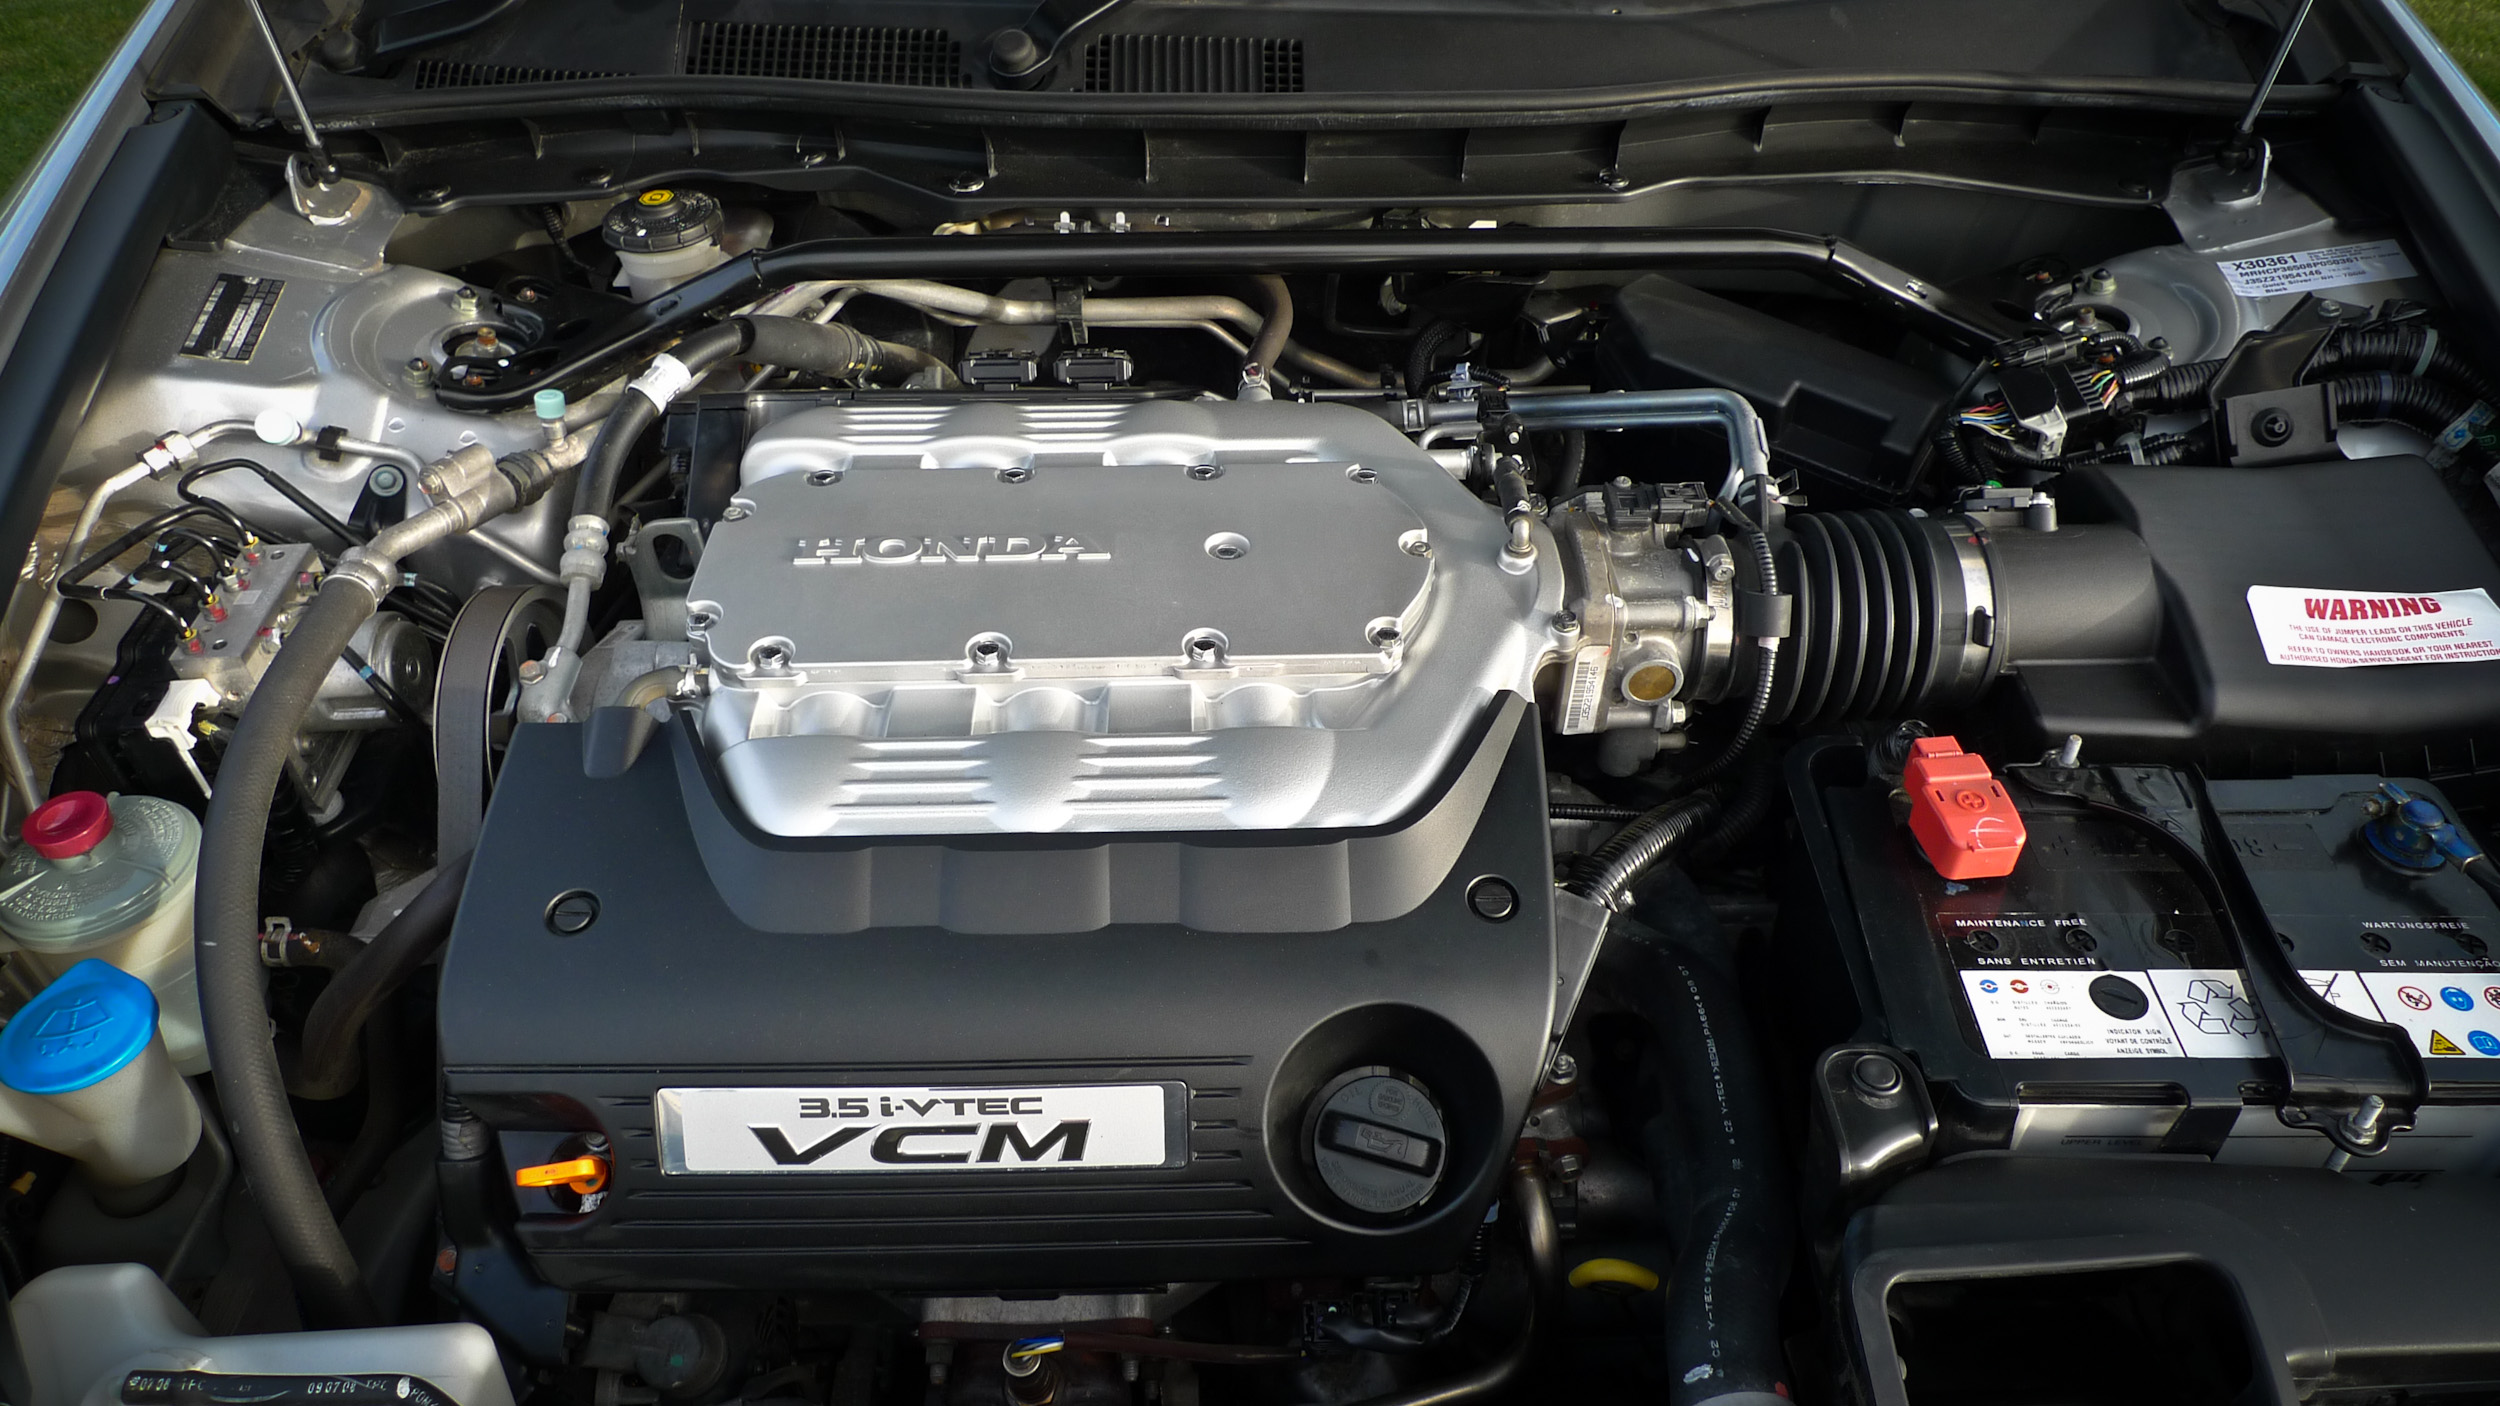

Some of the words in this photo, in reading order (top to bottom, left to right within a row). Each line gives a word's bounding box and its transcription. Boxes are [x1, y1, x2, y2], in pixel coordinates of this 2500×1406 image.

[2232, 254, 2297, 271] X30361
[2244, 269, 2322, 285] J35Z21954146
[793, 534, 1111, 564] HONDA
[2304, 597, 2442, 620] WARNING
[2289, 624, 2303, 632] THE
[2305, 625, 2320, 633] USE
[2335, 628, 2367, 636] JUMPER
[2369, 627, 2397, 636] LEADS
[2398, 625, 2412, 633] ON
[2412, 623, 2434, 632] THIS
[2435, 617, 2473, 630] VEHICLE
[2316, 634, 2349, 644] DAMAGE
[2351, 635, 2403, 644] ELECTRONIC
[2404, 629, 2469, 642] COMPONENTS.
[2287, 645, 2313, 653] REFER
[2327, 648, 2361, 656] OWNERS
[2363, 647, 2411, 657] HANDBOOK
[2412, 646, 2426, 654] OR
[2426, 644, 2453, 653] YOUR
[2454, 640, 2494, 650] NEAREST
[2279, 654, 2329, 663] AUTHORISED
[2330, 656, 2359, 665] HONDA
[2359, 656, 2395, 664] SERVICE
[2425, 653, 2443, 661] FOR
[1955, 919, 2046, 928] MAINTENANCE
[2054, 918, 2088, 927] FREE
[2362, 921, 2471, 930] WARTUNGSFREIE
[1978, 957, 2012, 966] SANS
[2020, 957, 2096, 966] ENTRETIEN
[2380, 959, 2407, 967] SEM
[799, 1097, 869, 1118] 3.5
[880, 1096, 1042, 1118] i-VTEC
[748, 1119, 1091, 1165] VCM
